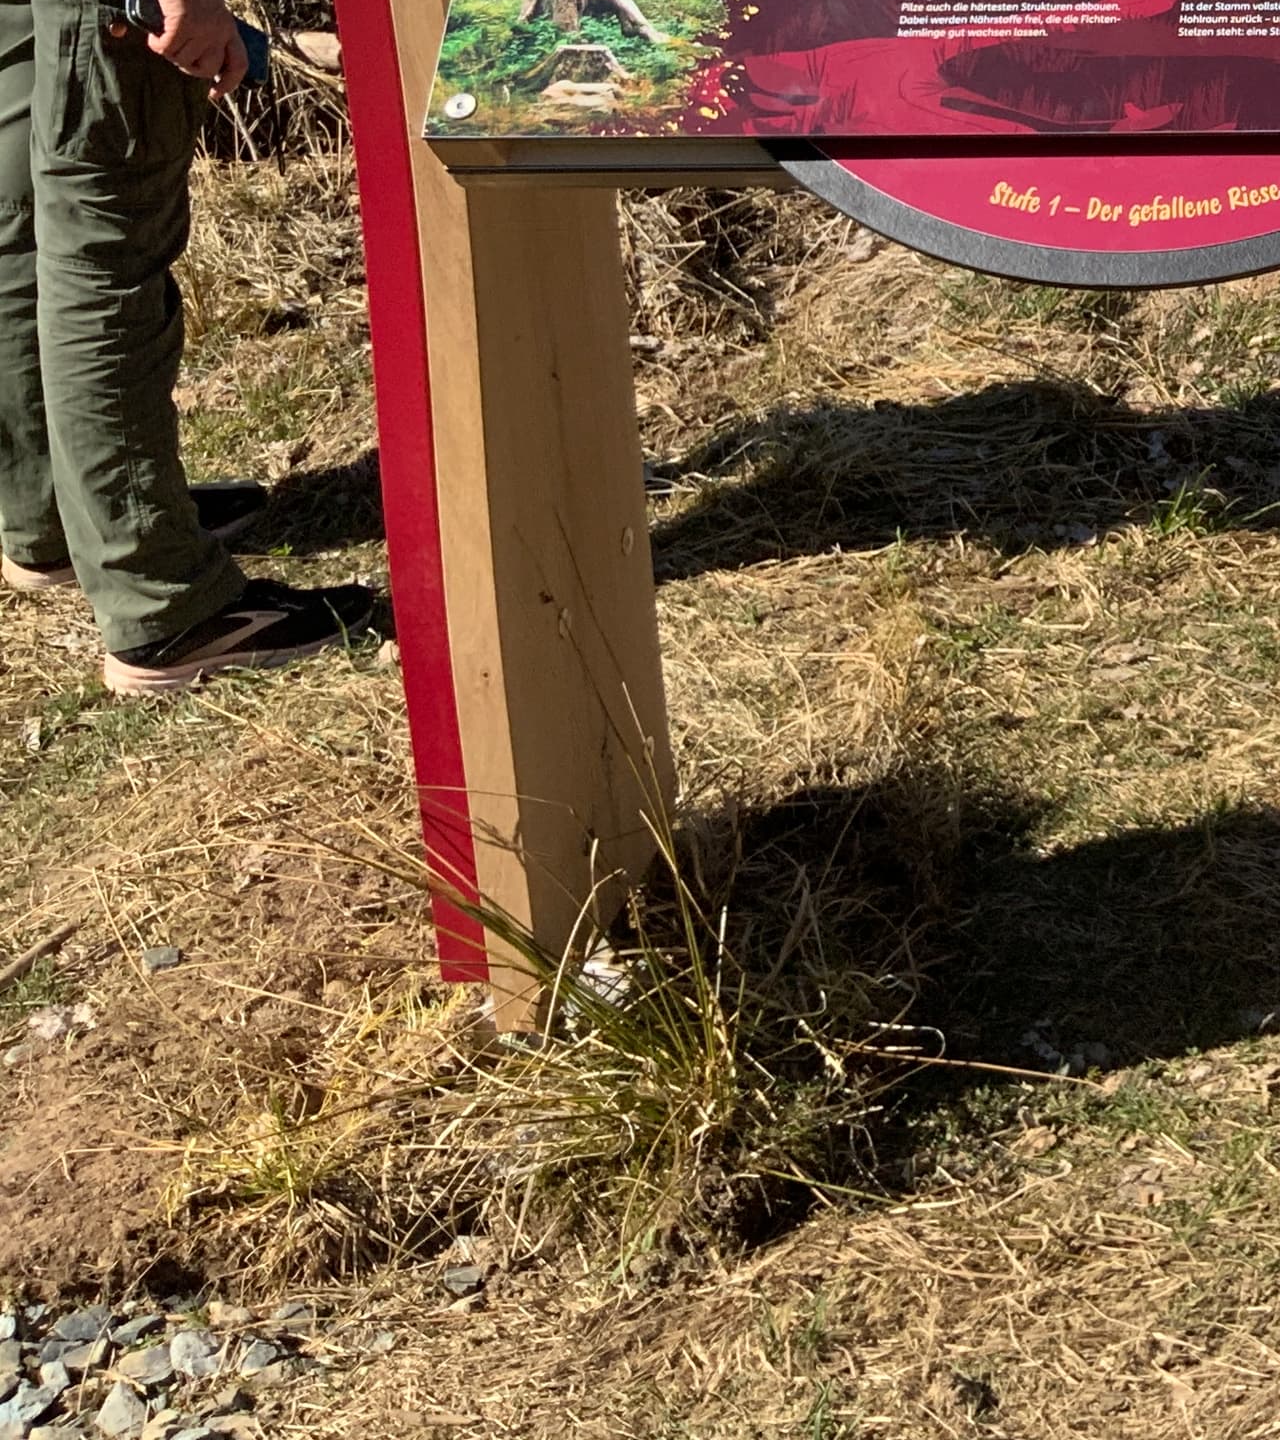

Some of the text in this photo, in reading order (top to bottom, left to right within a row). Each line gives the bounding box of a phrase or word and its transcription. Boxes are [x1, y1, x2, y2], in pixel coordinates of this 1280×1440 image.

[1178, 27, 1214, 37] Stelzen
[1216, 27, 1244, 36] steht:
[1246, 27, 1268, 36] eine
[989, 181, 1041, 214] Stufe
[1048, 196, 1060, 216] 1
[1087, 196, 1122, 222] Der
[1129, 196, 1222, 226] gefallene
